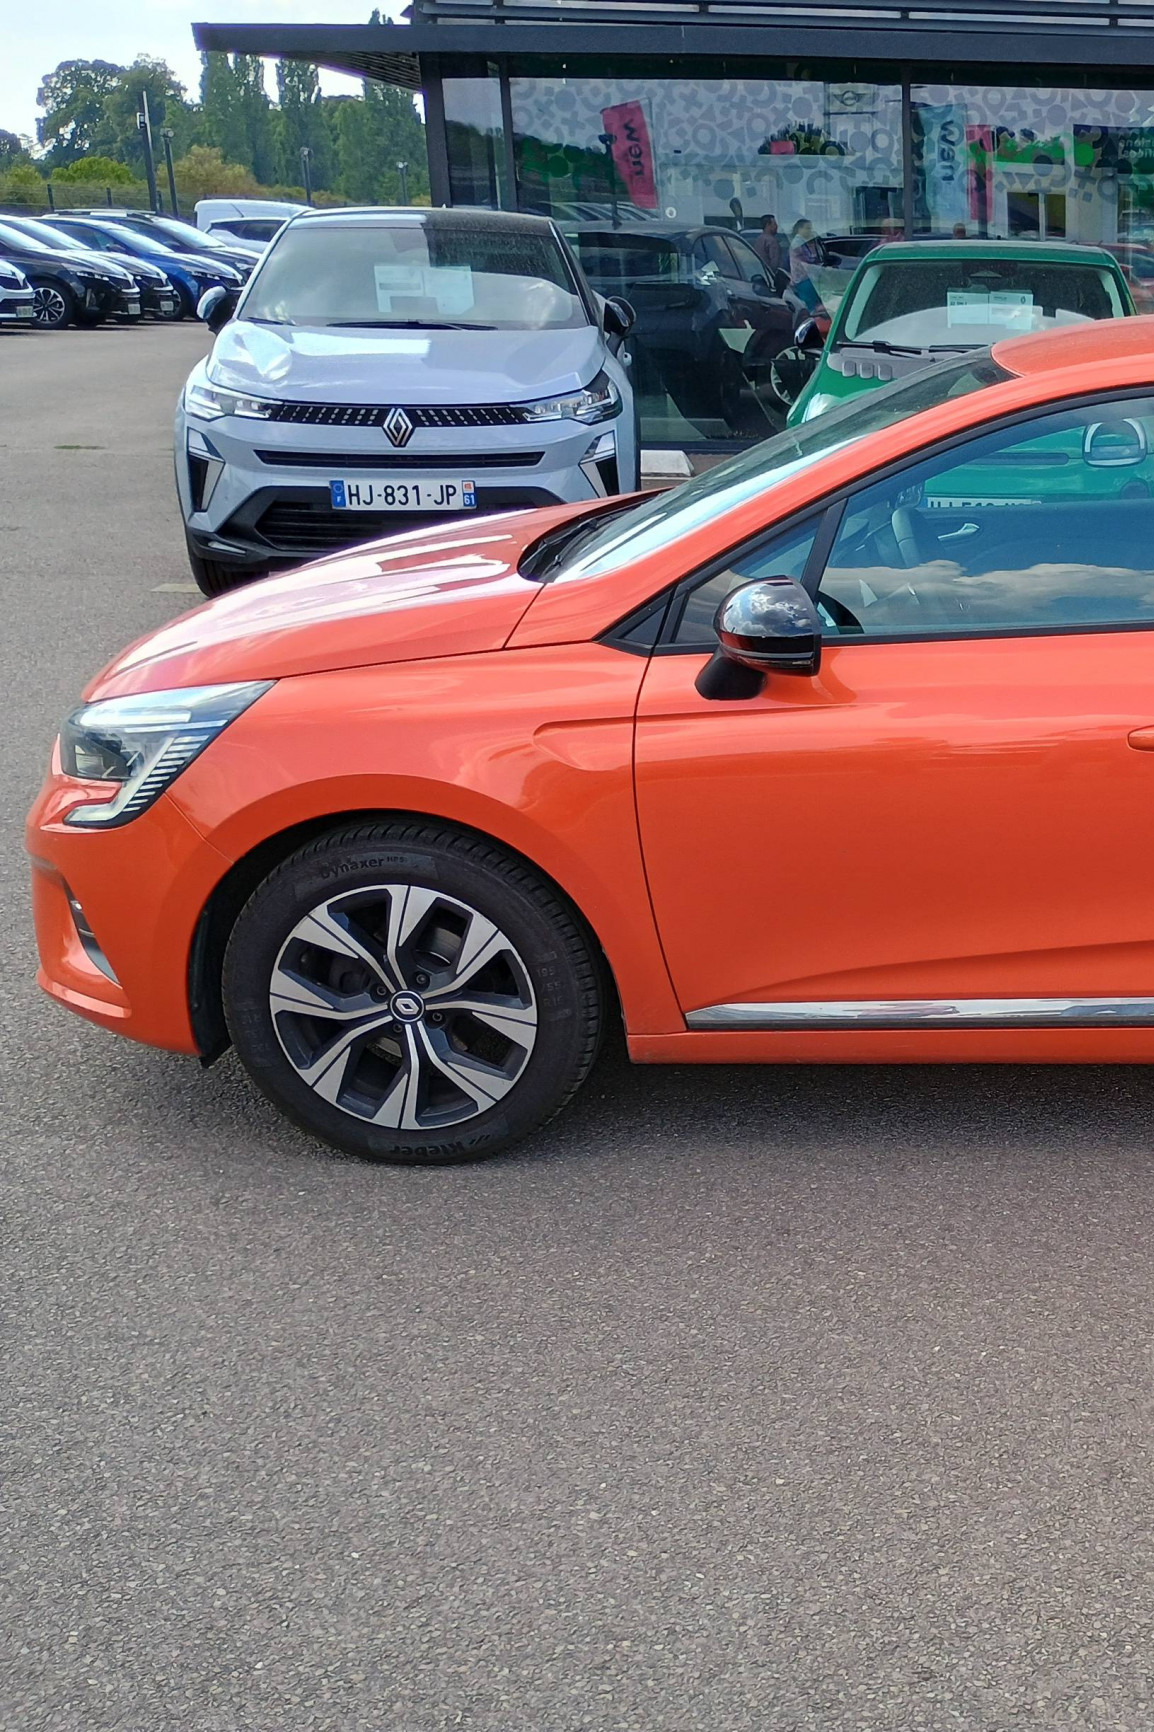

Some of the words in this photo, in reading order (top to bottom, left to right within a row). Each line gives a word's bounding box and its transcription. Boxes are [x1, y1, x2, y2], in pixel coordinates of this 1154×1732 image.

[347, 484, 457, 506] HJ-831-JP
[464, 494, 476, 505] 61
[319, 857, 386, 880] Dynaxer
[389, 1140, 466, 1158] Kleber
